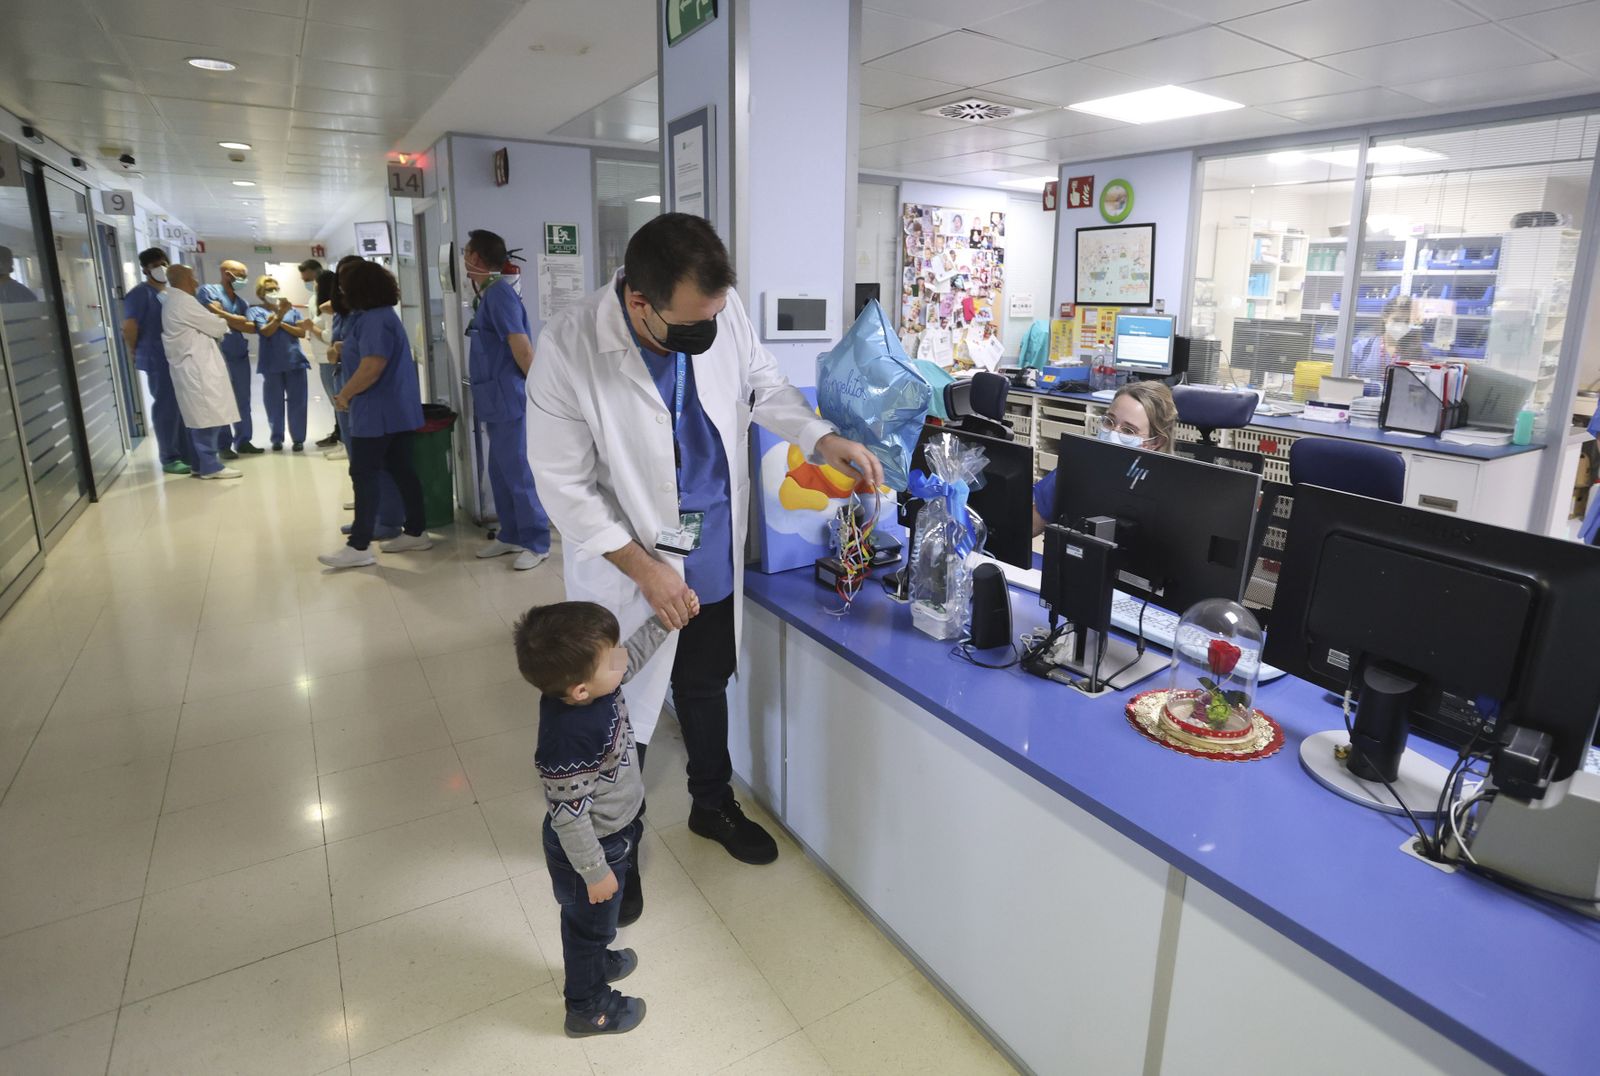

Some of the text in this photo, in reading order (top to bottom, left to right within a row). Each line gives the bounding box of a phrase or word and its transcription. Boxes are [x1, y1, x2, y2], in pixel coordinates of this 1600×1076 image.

[392, 172, 420, 192] 14
[111, 194, 125, 211] 9
[166, 227, 182, 239] 10
